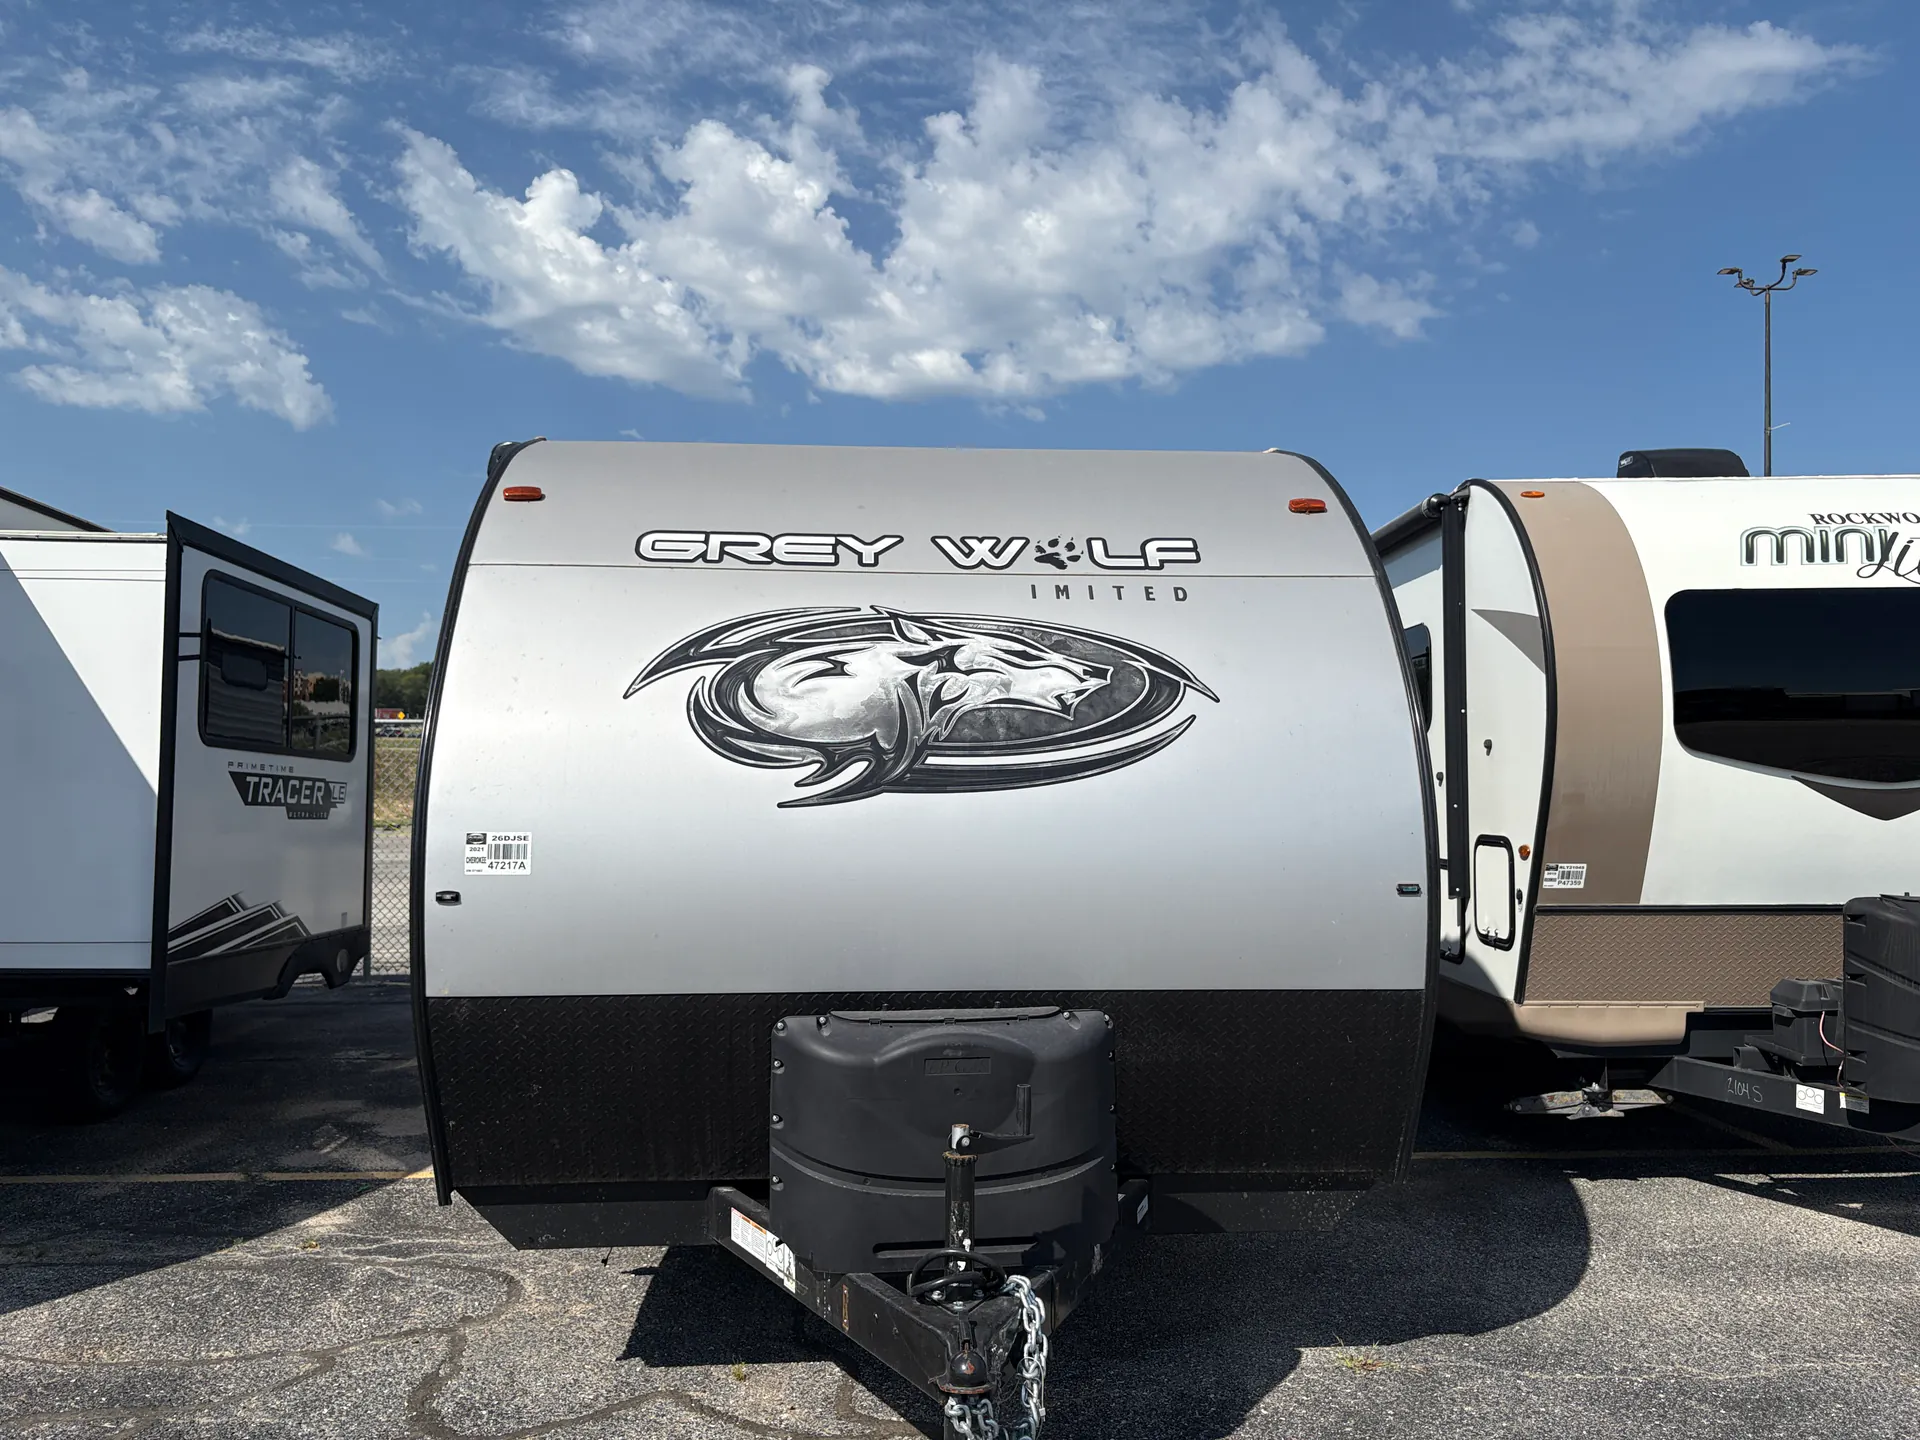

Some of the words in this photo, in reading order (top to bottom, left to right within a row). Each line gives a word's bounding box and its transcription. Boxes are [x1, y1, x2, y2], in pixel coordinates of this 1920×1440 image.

[635, 530, 904, 567] GREY
[1031, 584, 1188, 603] IMITED
[228, 761, 294, 773] PRIMETIME
[246, 776, 325, 805] TRACER
[332, 784, 346, 800] LE
[487, 861, 526, 870] 47217A
